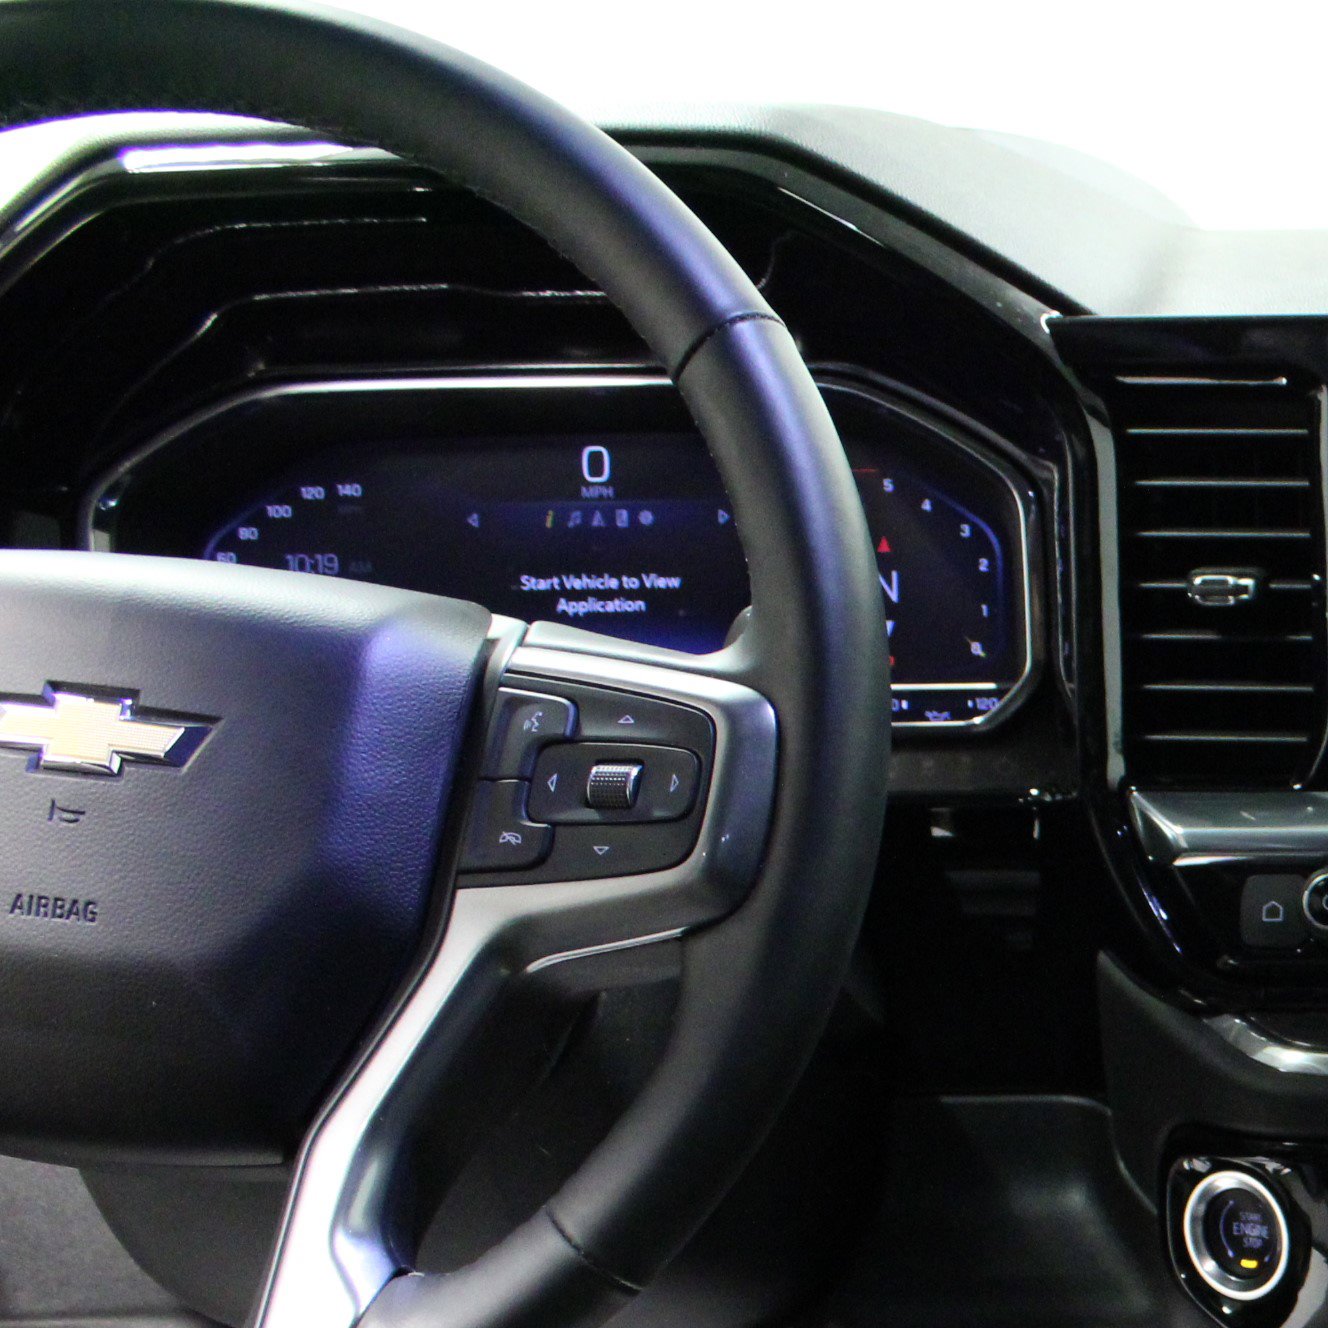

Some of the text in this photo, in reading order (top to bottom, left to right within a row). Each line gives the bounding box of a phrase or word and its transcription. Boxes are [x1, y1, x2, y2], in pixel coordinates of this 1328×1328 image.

[581, 445, 611, 483] 0
[336, 483, 363, 497] 140
[580, 485, 615, 498] MPH
[883, 477, 895, 492] 5
[300, 486, 325, 500] 120
[266, 504, 293, 518] 100
[920, 498, 932, 512] 4
[237, 527, 259, 540] 80
[960, 524, 971, 538] 3
[285, 553, 340, 575] 10:19
[978, 558, 990, 572] 2
[519, 573, 682, 591] Start Vehicle to View
[556, 597, 647, 616] Application
[981, 604, 990, 617] 1
[9, 893, 98, 923] AIRBAG
